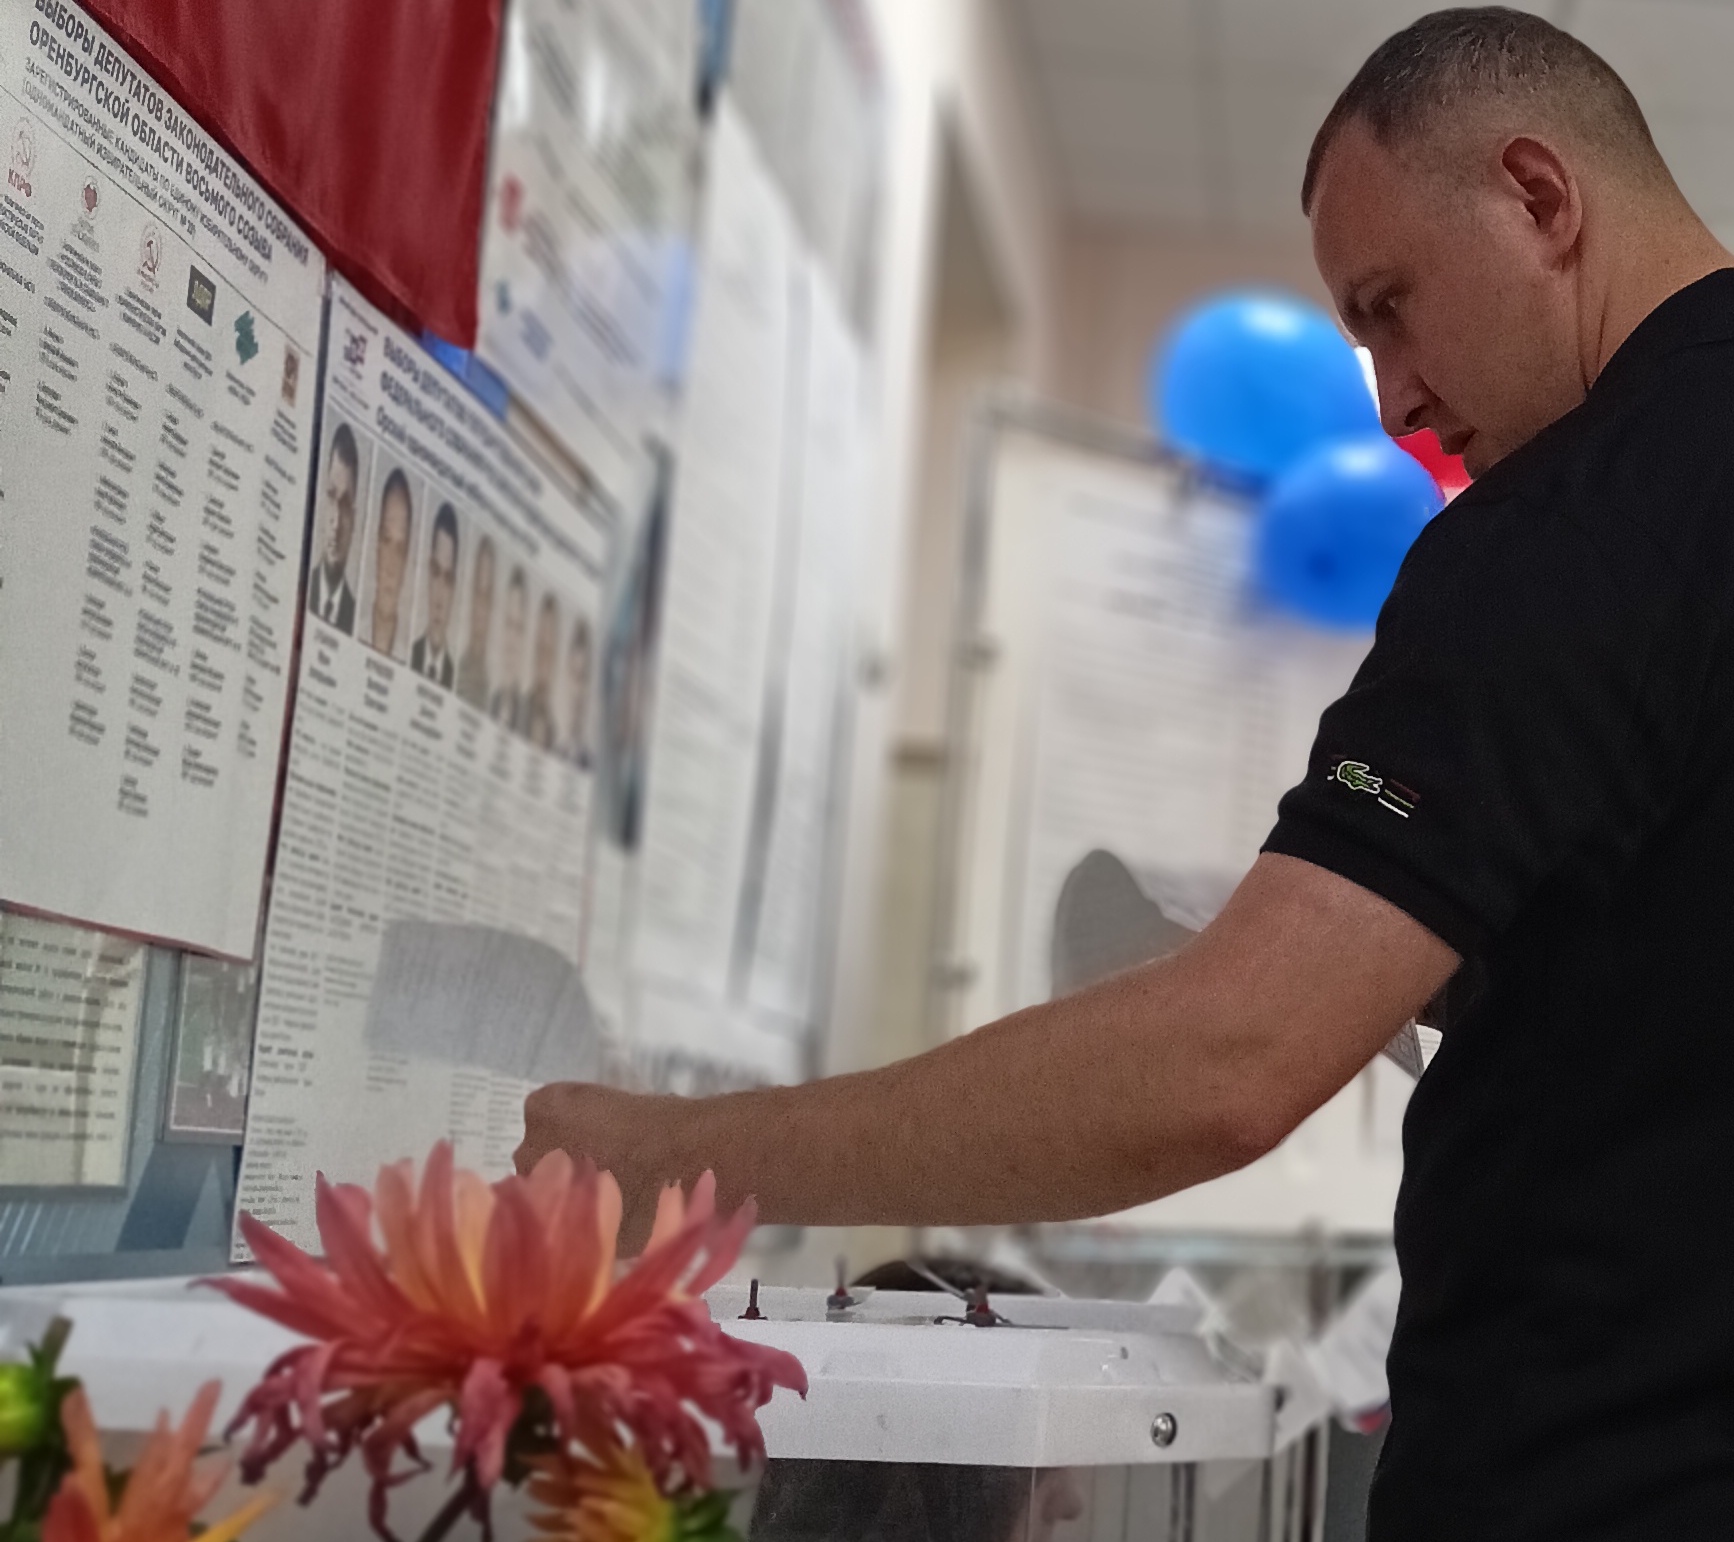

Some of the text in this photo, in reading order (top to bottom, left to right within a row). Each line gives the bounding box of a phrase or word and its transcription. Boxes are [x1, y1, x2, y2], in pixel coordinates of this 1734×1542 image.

[30, 20, 272, 262] ОРЕНБУРГСКОЙ ОБЛАСТИ ВОСЬМОГО СОЗЫВА
[94, 42, 164, 122] ДЕПУТАТОВ
[165, 108, 265, 222] ЗАКОНОДАТЕЛЬНОГО
[265, 210, 309, 267] СОБРАНИЯ
